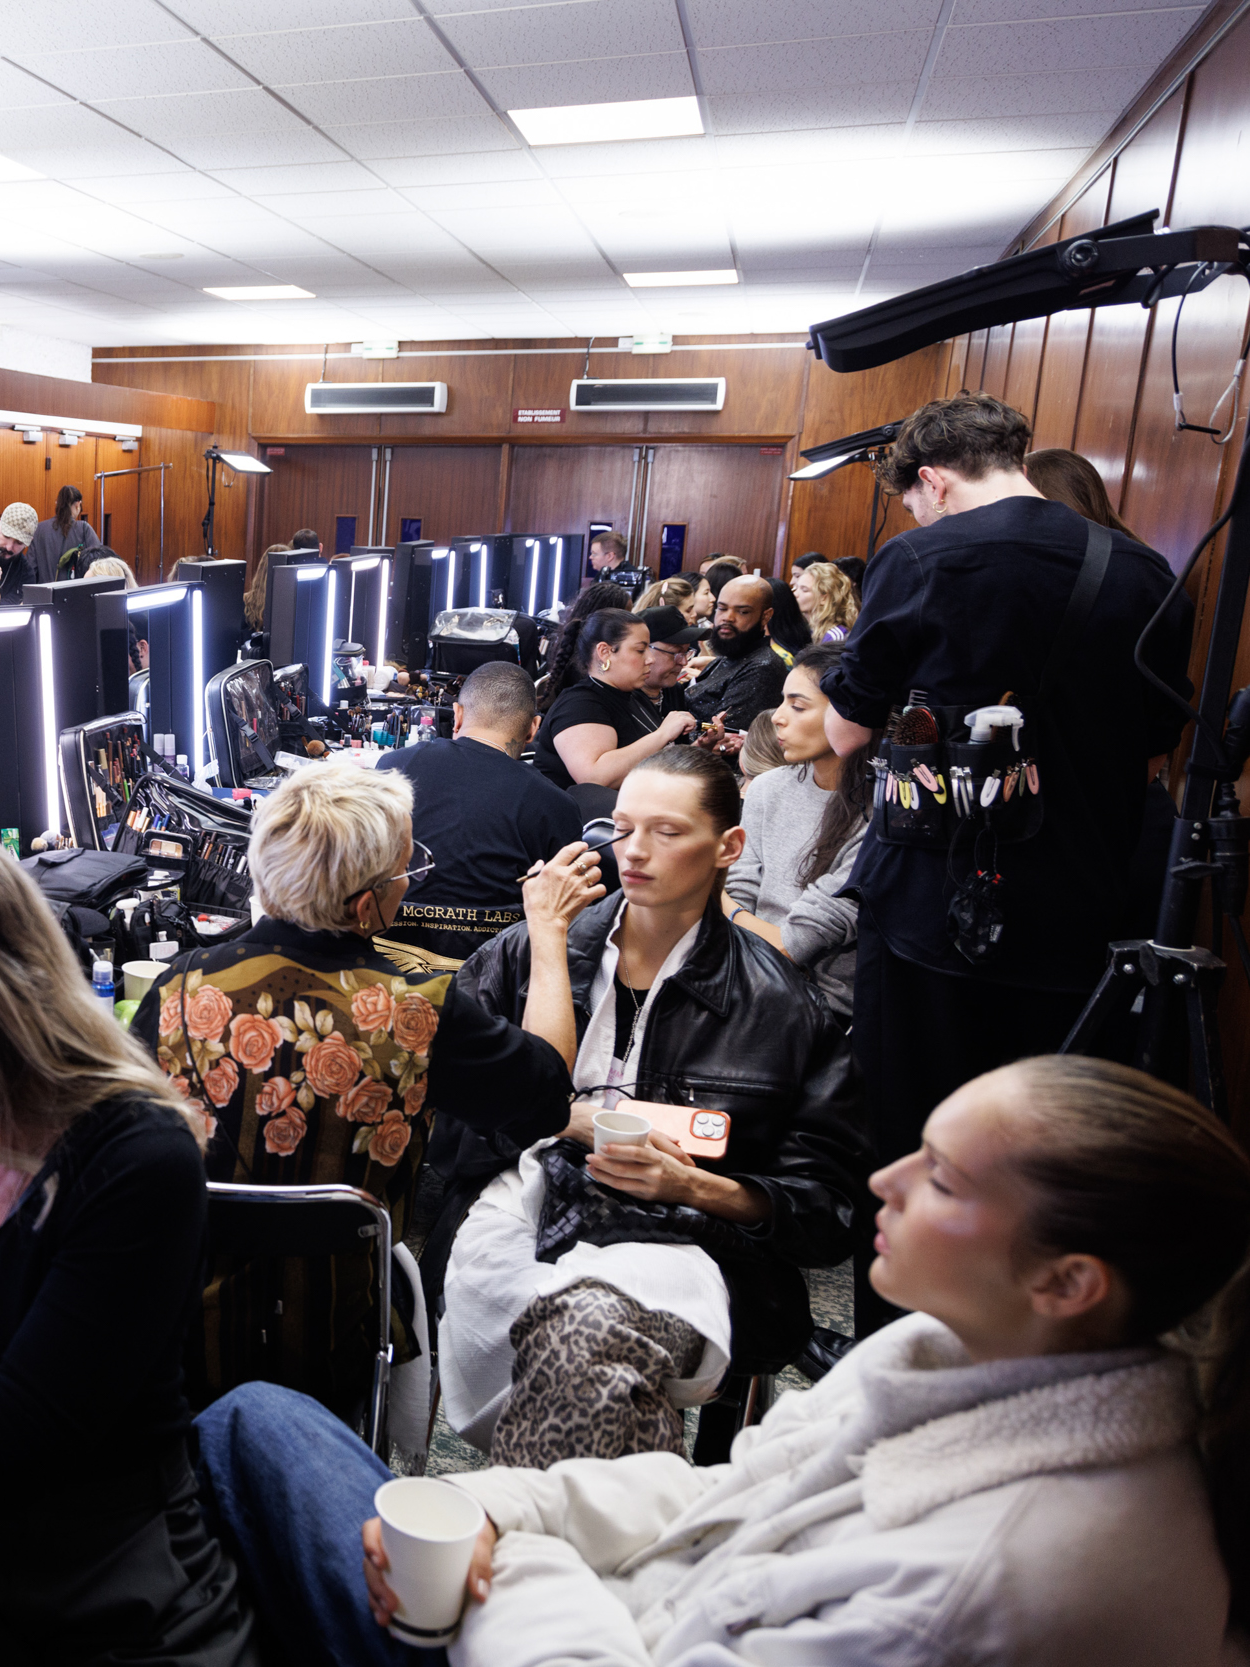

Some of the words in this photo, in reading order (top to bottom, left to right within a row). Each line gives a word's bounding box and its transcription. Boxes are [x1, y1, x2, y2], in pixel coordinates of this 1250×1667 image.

[402, 905, 477, 921] McGRATH
[484, 910, 521, 923] LABS
[421, 921, 472, 931] INSPIRATION.
[473, 925, 502, 934] ADDICTI
